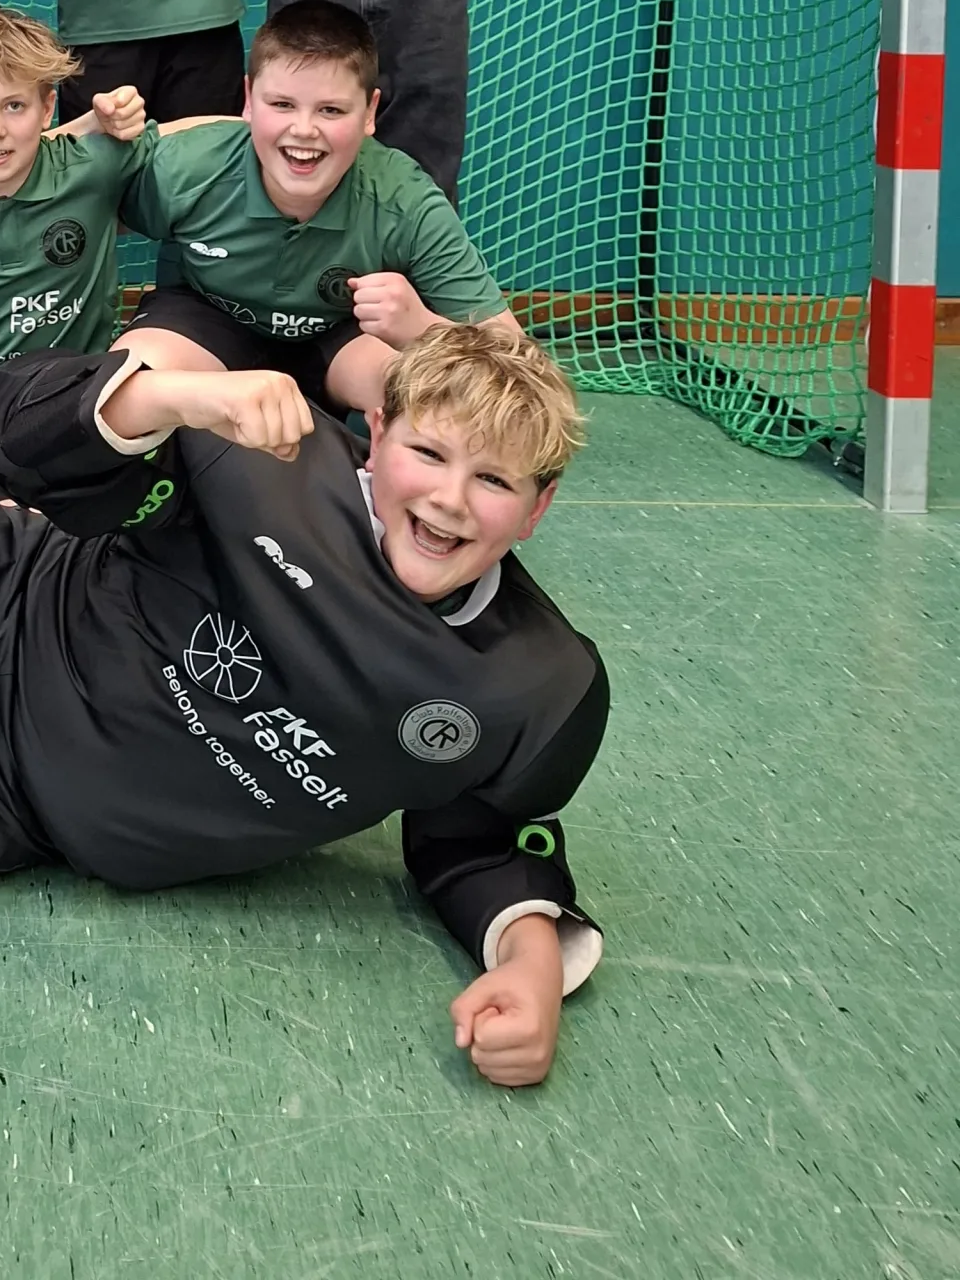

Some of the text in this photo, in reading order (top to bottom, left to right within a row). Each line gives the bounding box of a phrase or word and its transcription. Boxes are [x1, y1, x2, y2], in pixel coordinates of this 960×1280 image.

[11, 290, 60, 313] PKF
[162, 665, 277, 809] Belong together.
[265, 707, 337, 758] PKF
[410, 706, 434, 724] Club
[242, 711, 348, 810] Fasselt
